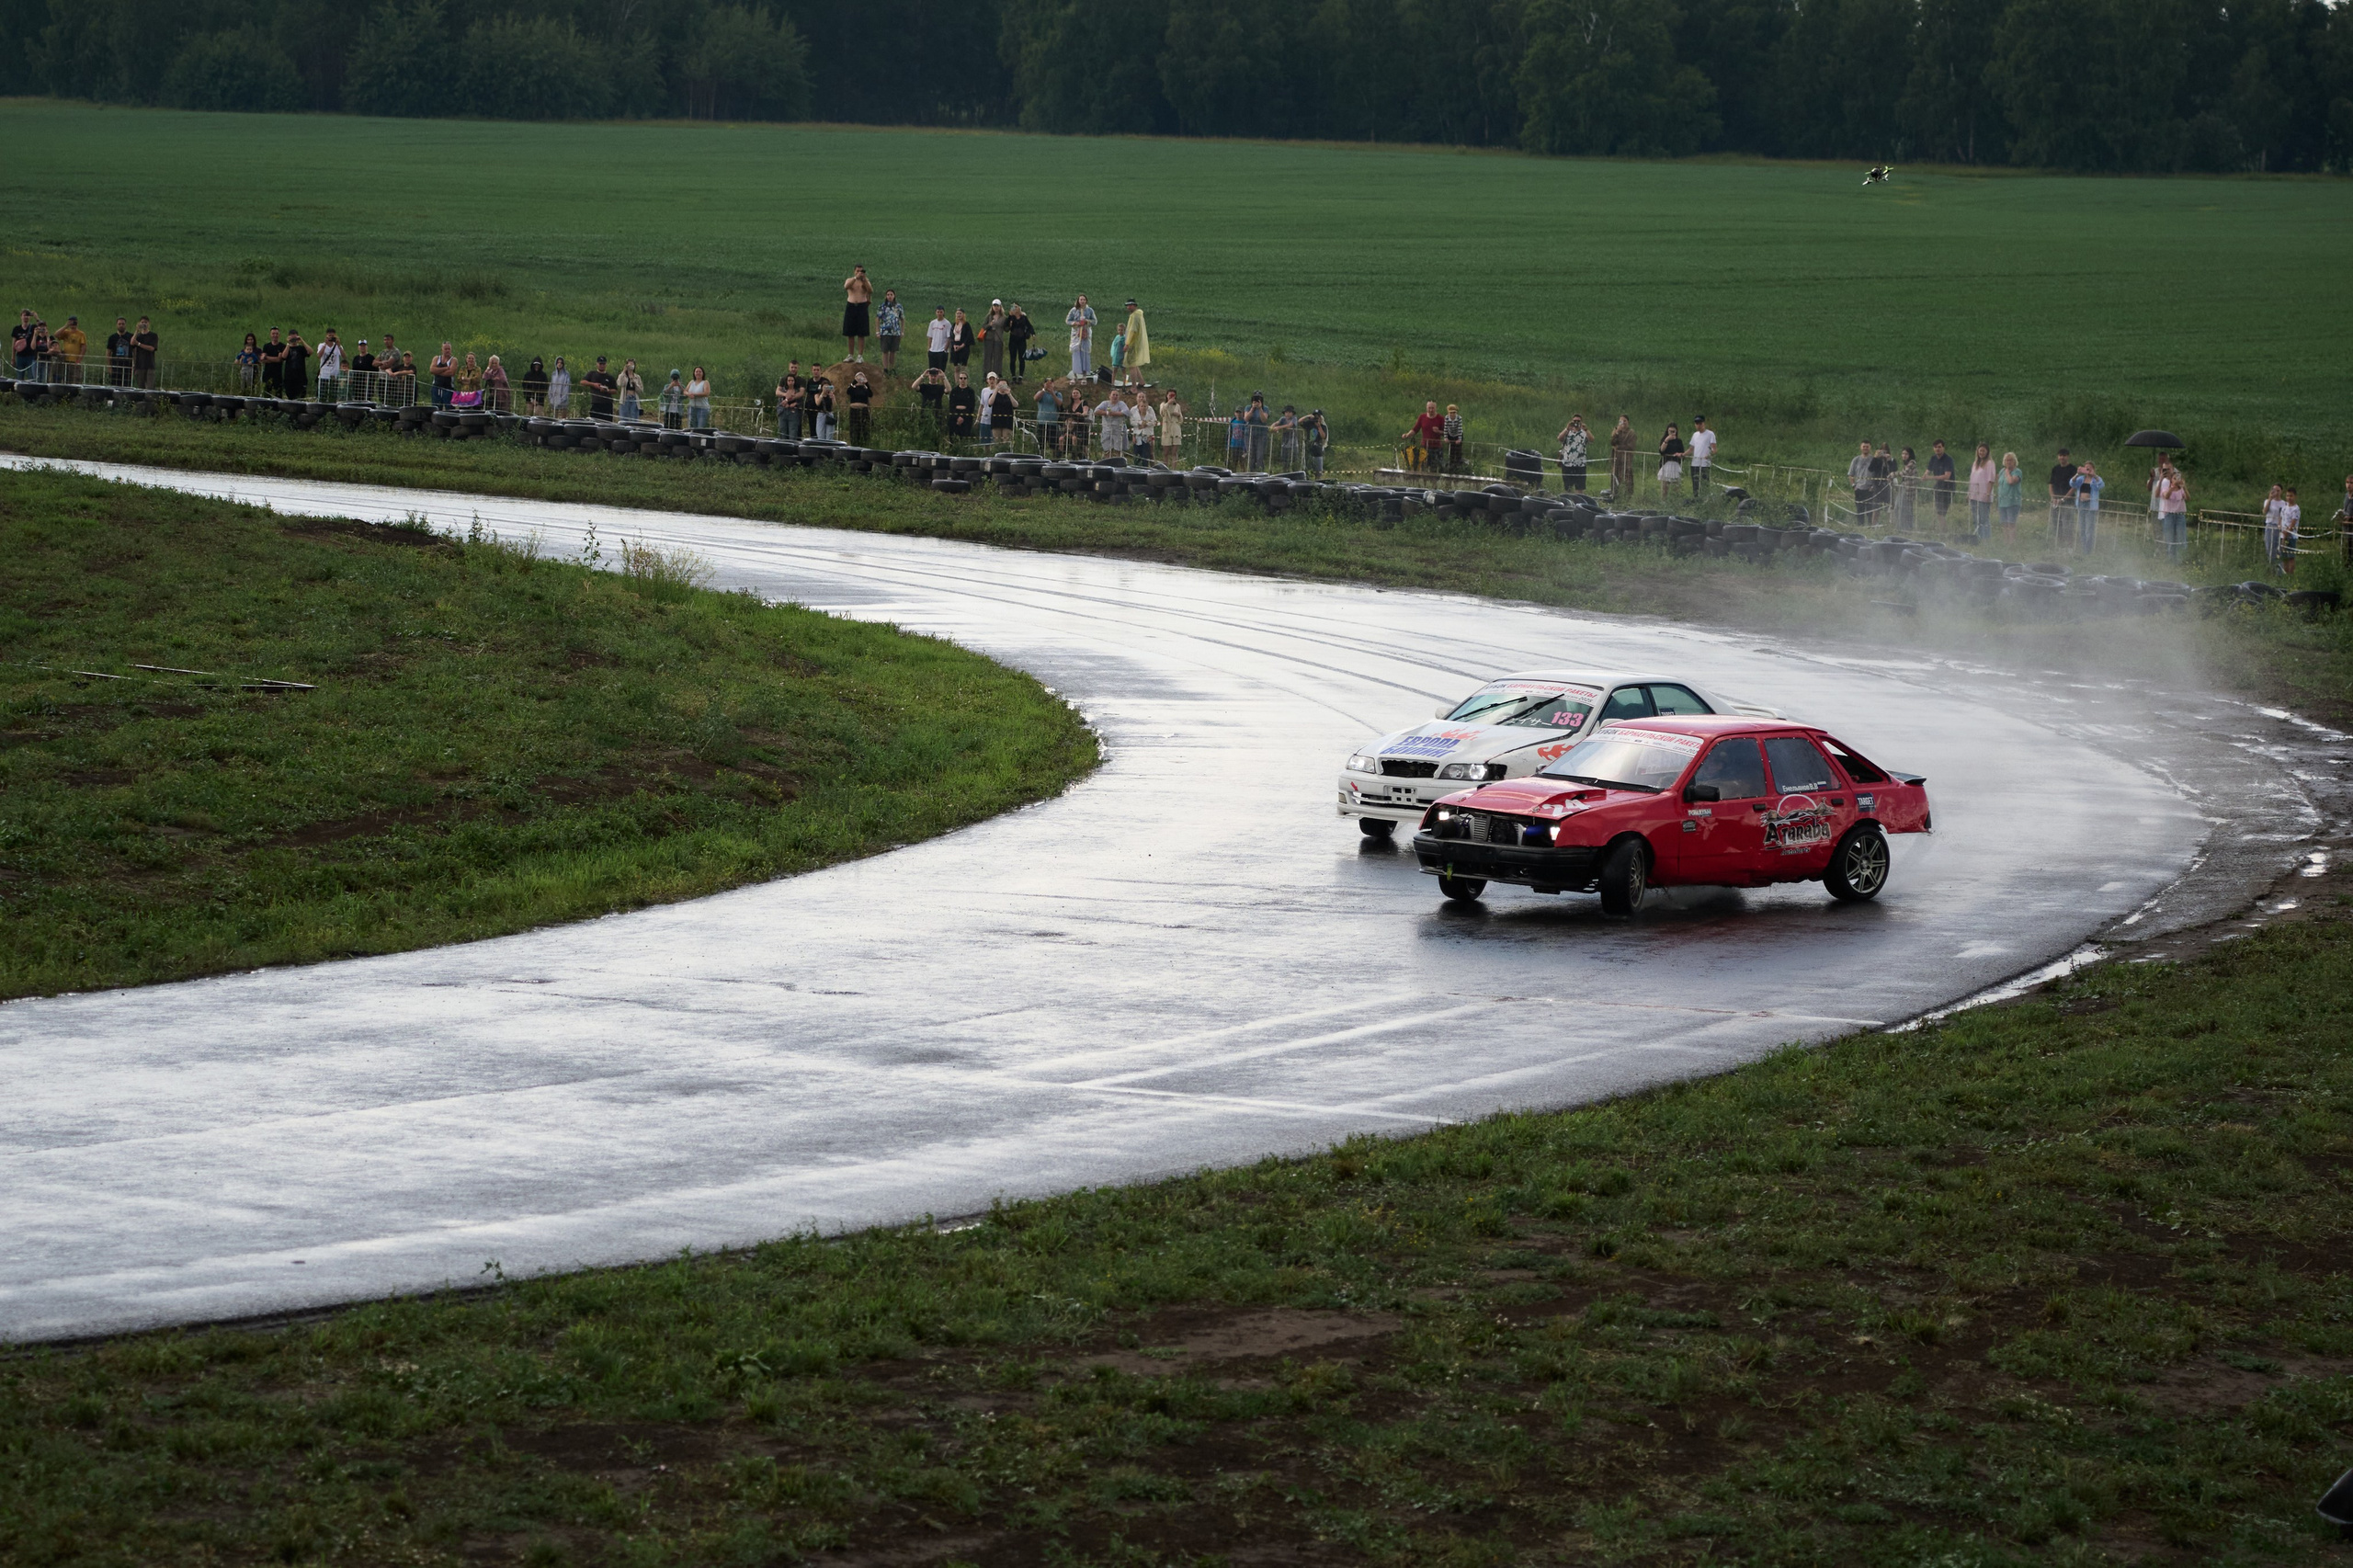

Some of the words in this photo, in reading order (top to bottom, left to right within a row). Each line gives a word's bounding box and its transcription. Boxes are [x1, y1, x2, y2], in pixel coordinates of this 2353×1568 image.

[1507, 683, 1565, 693] БАРНАУЛЬСКОЙ
[1565, 687, 1597, 699] РАКЕТЫ
[1551, 710, 1585, 727] 133
[1395, 735, 1461, 749] ЕВРОПА
[1618, 729, 1677, 743] БАРНАУЛЬСКОЙ
[1380, 745, 1456, 758] БОУЛИНГ
[1541, 799, 1592, 817] 24
[1857, 796, 1874, 806] TARGET
